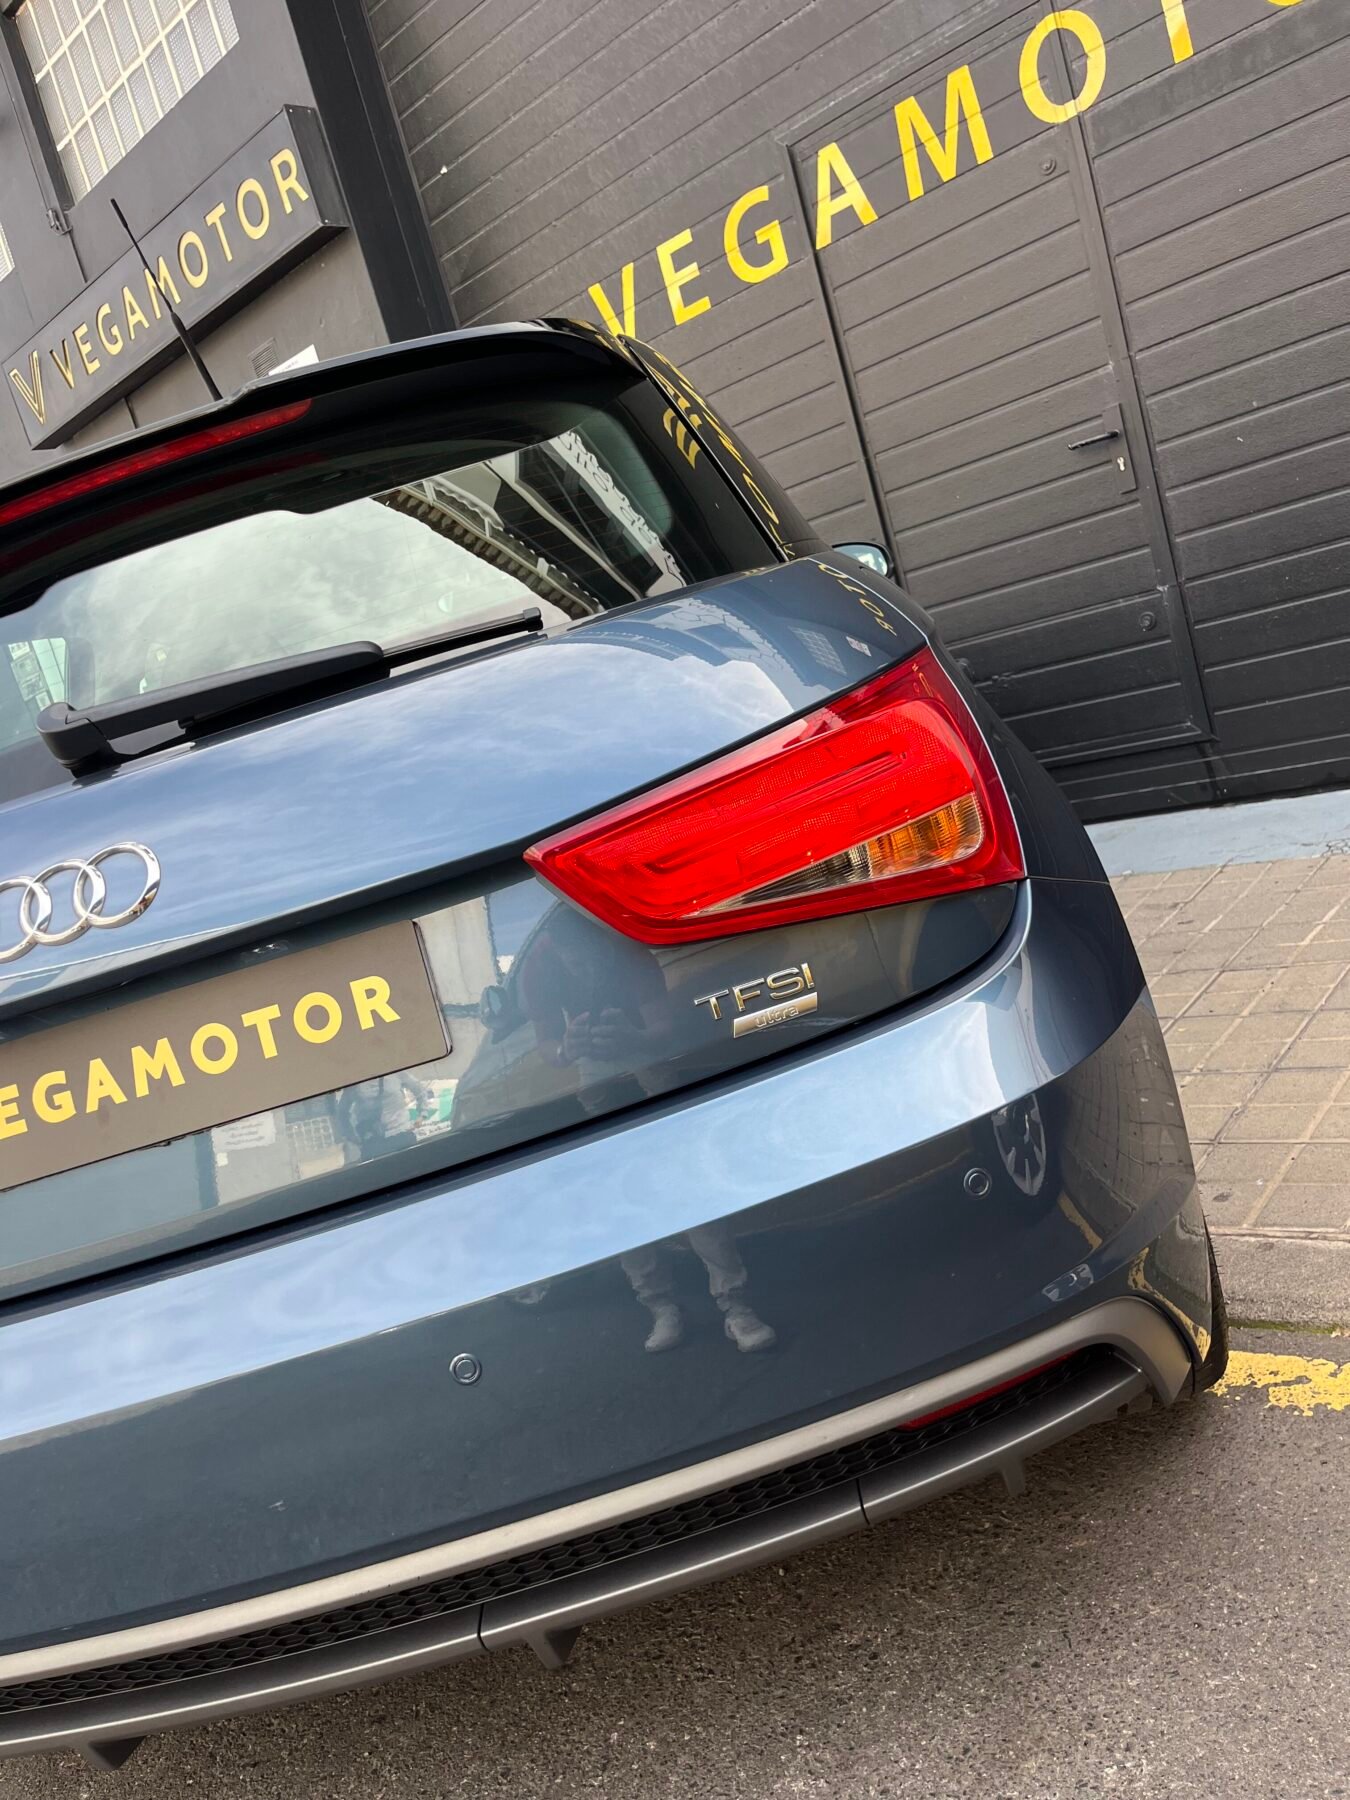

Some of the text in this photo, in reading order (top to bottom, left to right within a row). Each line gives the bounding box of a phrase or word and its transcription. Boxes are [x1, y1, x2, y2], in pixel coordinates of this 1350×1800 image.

[587, 0, 1304, 340] VEGAMO
[50, 148, 310, 390] VEGAMOTOR
[694, 962, 816, 1021] TFSI
[755, 1004, 801, 1028] ultra
